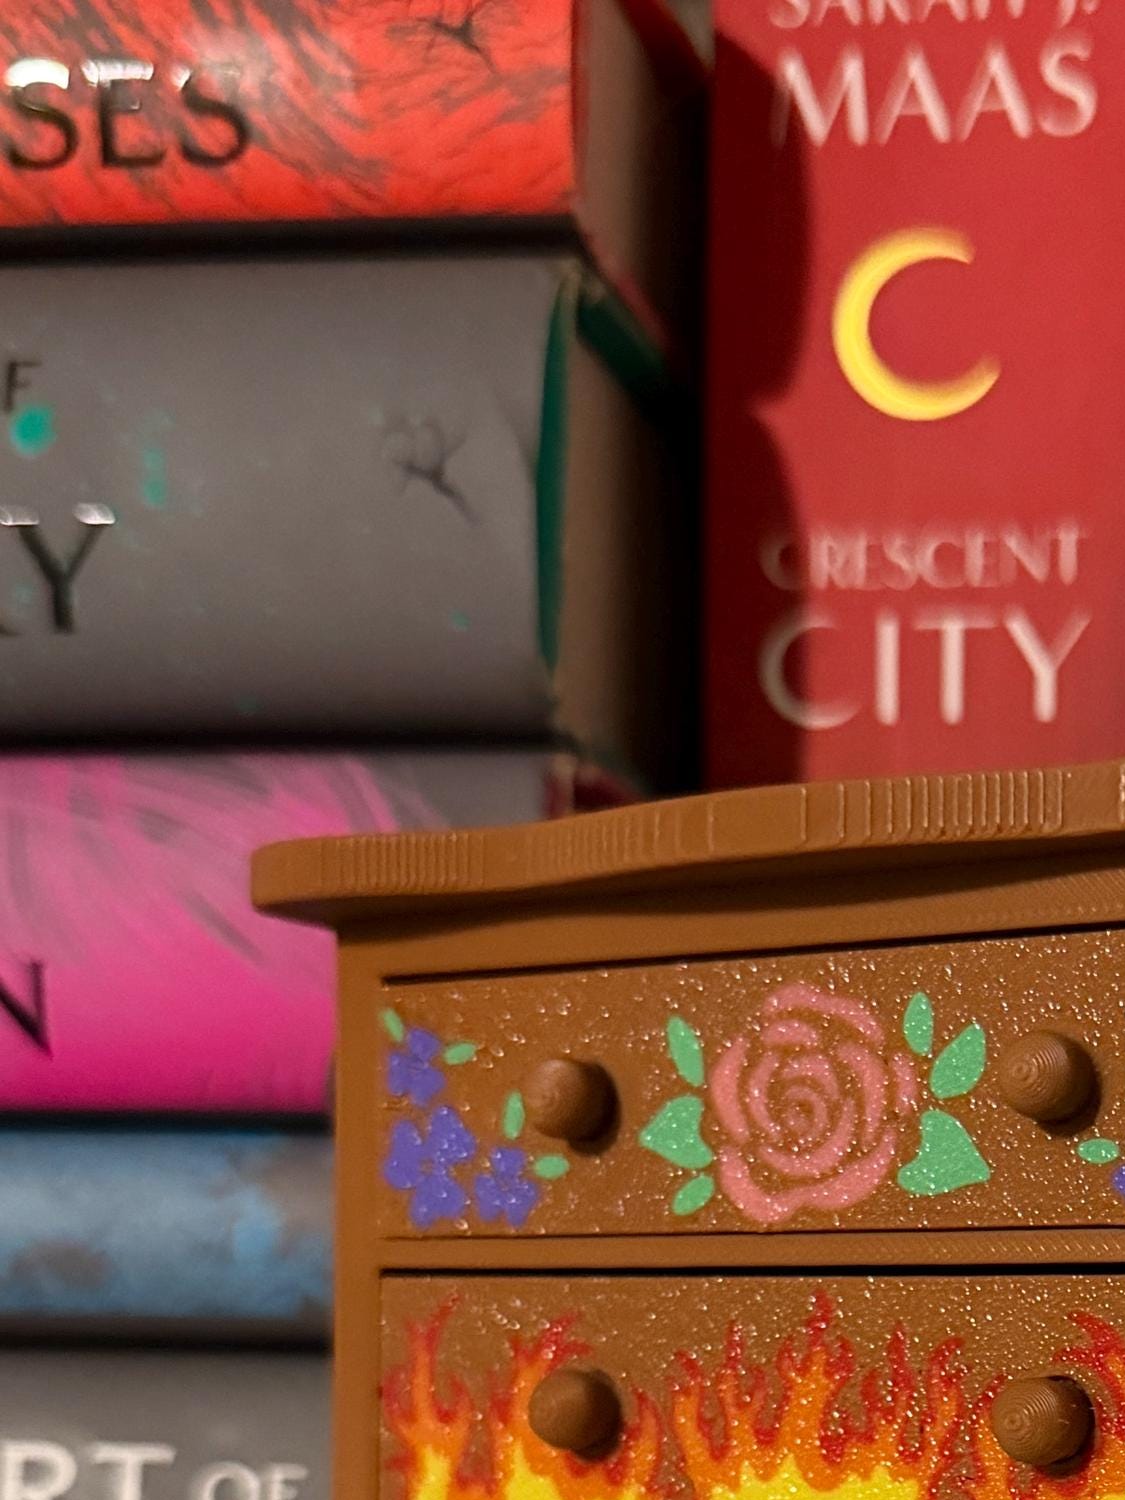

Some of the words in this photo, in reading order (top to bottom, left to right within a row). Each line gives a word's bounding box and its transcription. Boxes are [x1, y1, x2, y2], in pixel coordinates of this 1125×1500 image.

[4, 57, 253, 170] SES
[770, 35, 1098, 147] MAAS
[0, 502, 116, 636] Y
[759, 522, 1086, 591] CRESCENT
[758, 602, 1093, 731] CITY
